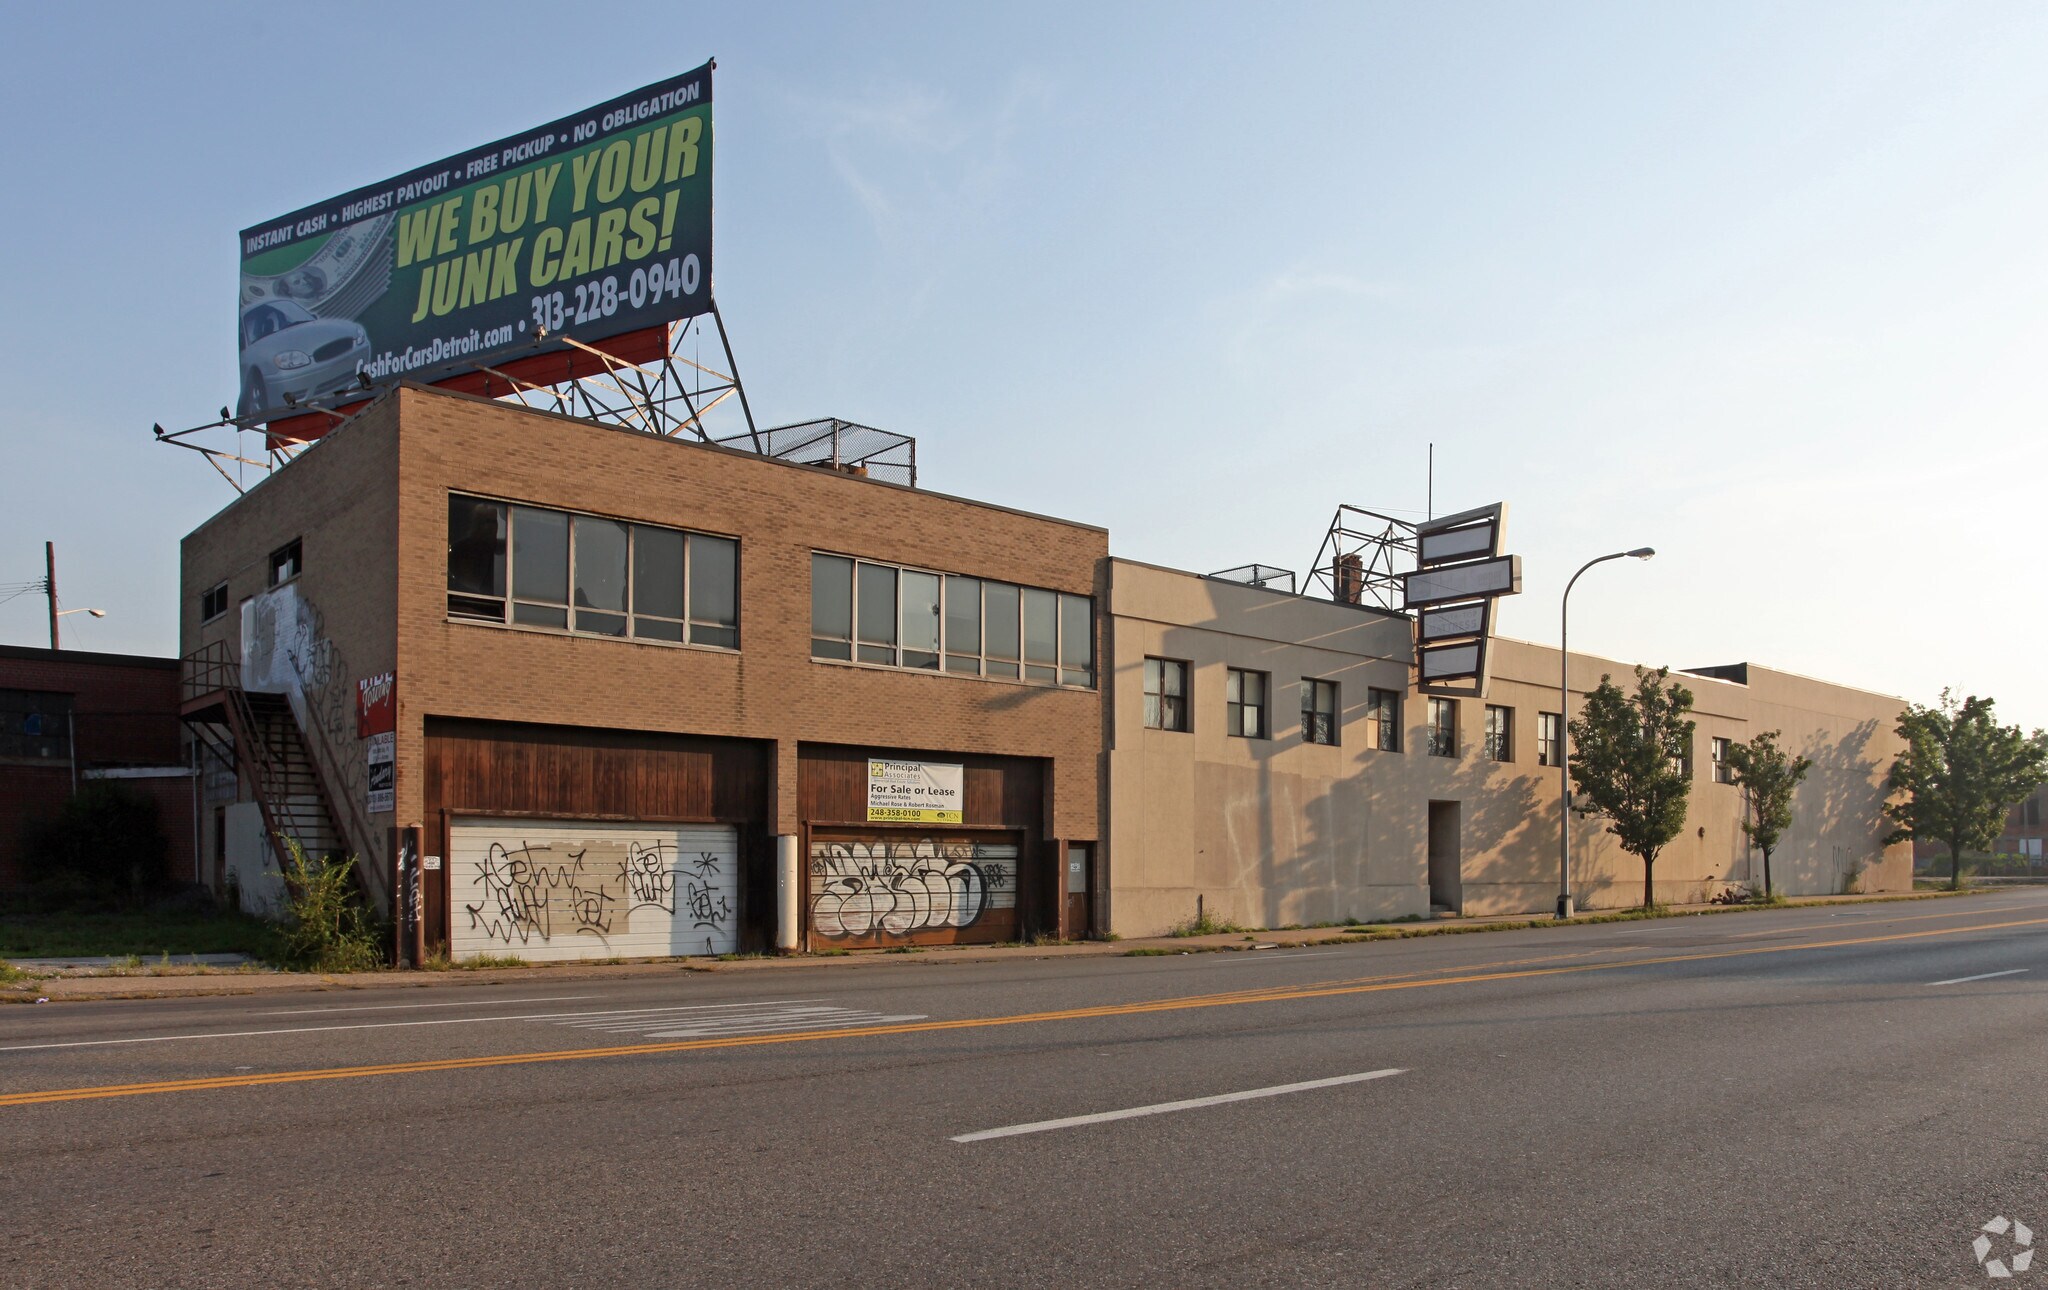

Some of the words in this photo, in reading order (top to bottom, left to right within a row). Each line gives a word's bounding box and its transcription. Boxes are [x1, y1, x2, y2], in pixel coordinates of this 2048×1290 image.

[246, 225, 294, 254] INSTANT
[296, 213, 327, 237] CASH
[342, 190, 394, 222] HIGHEST
[396, 170, 450, 203] PAYOUT
[466, 153, 498, 179] FREE
[502, 134, 555, 166] PICKUP
[573, 120, 597, 143] NO
[602, 81, 700, 131] OBLIGATION
[397, 195, 463, 269] WE
[468, 162, 563, 245] BUY
[572, 116, 703, 214] YOUR
[411, 236, 525, 324] JUNK
[529, 188, 681, 288] CARS!
[355, 323, 513, 379] CashForCarsDetroit.com
[531, 253, 701, 331] 313-228-0940
[362, 682, 391, 717] Towing
[870, 784, 888, 793] For
[890, 784, 912, 794] Sale
[914, 787, 925, 795] or
[928, 786, 955, 796] Lease
[884, 763, 921, 773] Principal
[884, 772, 921, 780] Associates
